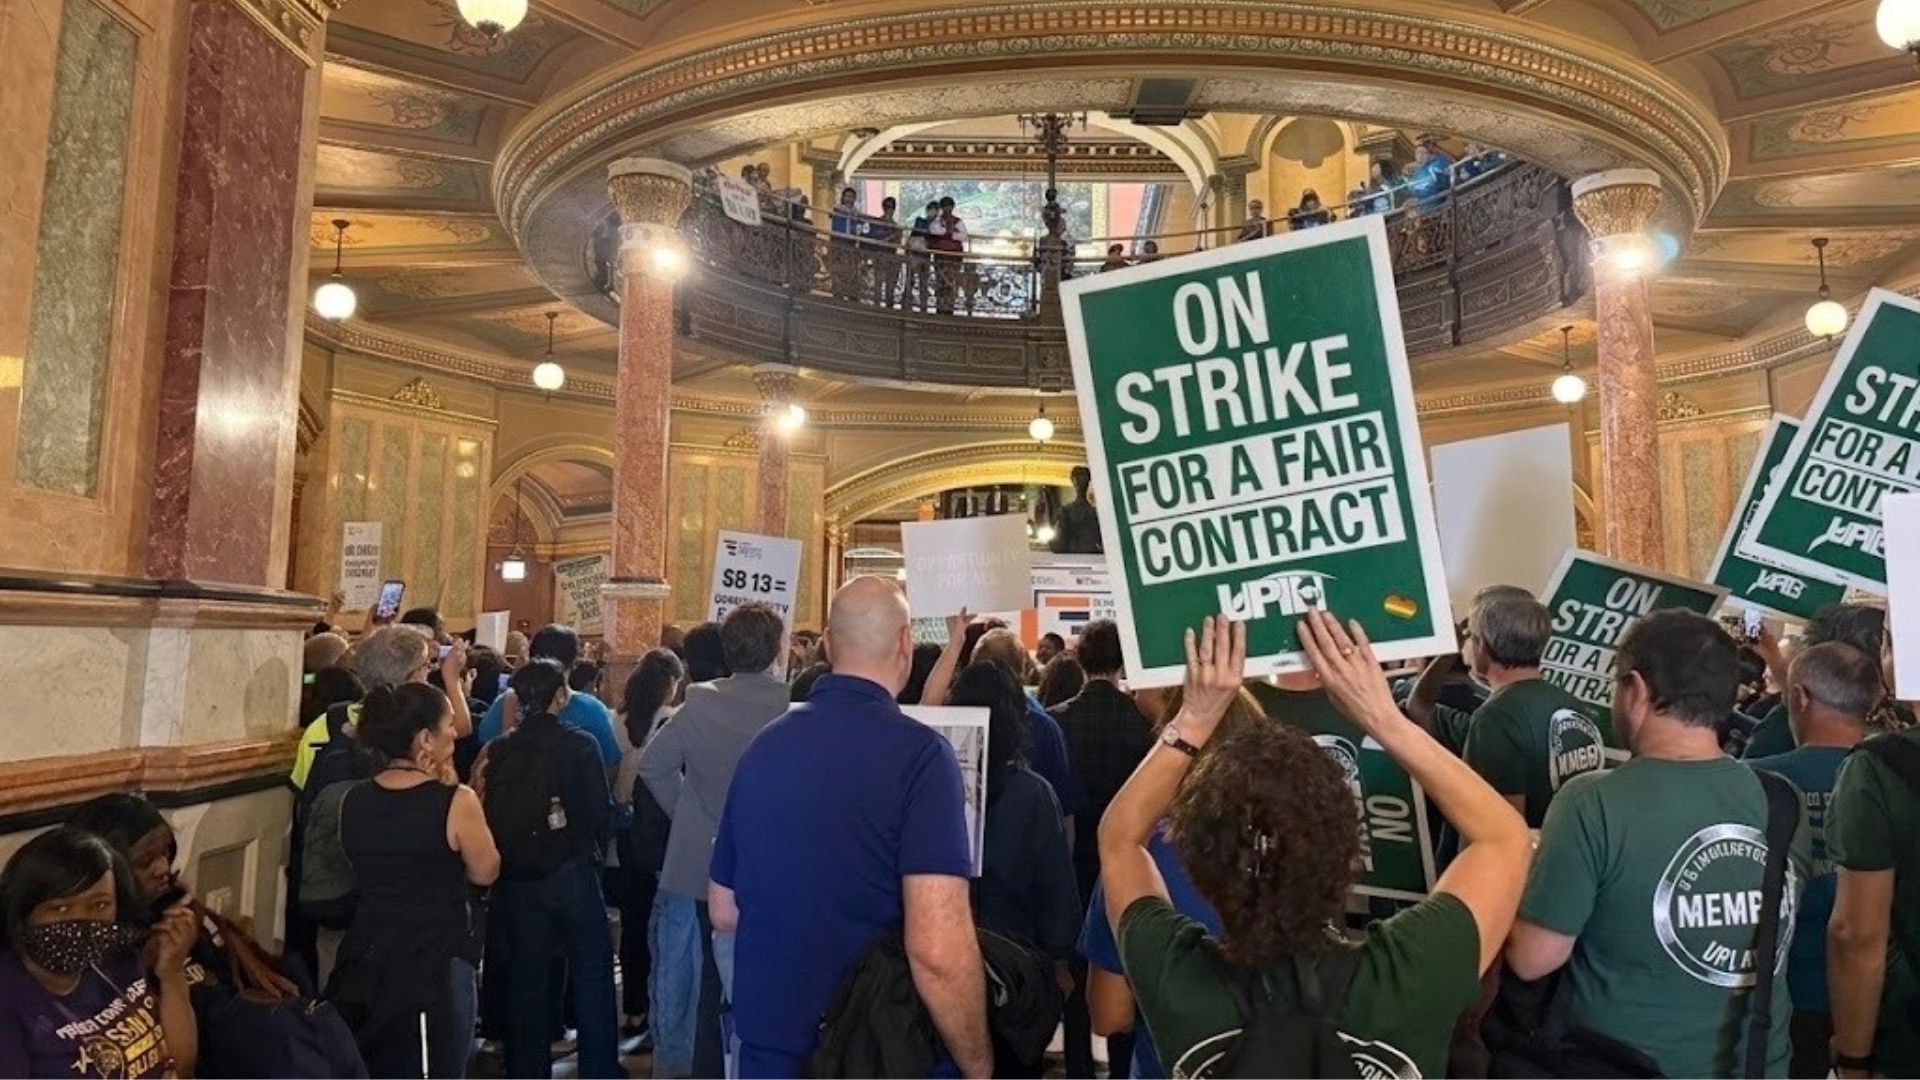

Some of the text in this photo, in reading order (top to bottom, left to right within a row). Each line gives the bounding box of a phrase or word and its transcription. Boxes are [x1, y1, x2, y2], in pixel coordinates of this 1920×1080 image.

[1172, 271, 1270, 356] ON
[1115, 334, 1359, 445] STRIKE
[1121, 418, 1387, 516] FOR A FAIR
[1815, 424, 1912, 476] FOR A
[1799, 463, 1909, 513] CONT
[1140, 485, 1390, 579] CONTRACT
[722, 568, 747, 589] SB
[1605, 576, 1663, 616] ON
[1583, 649, 1603, 671] A
[1365, 794, 1413, 843] ON
